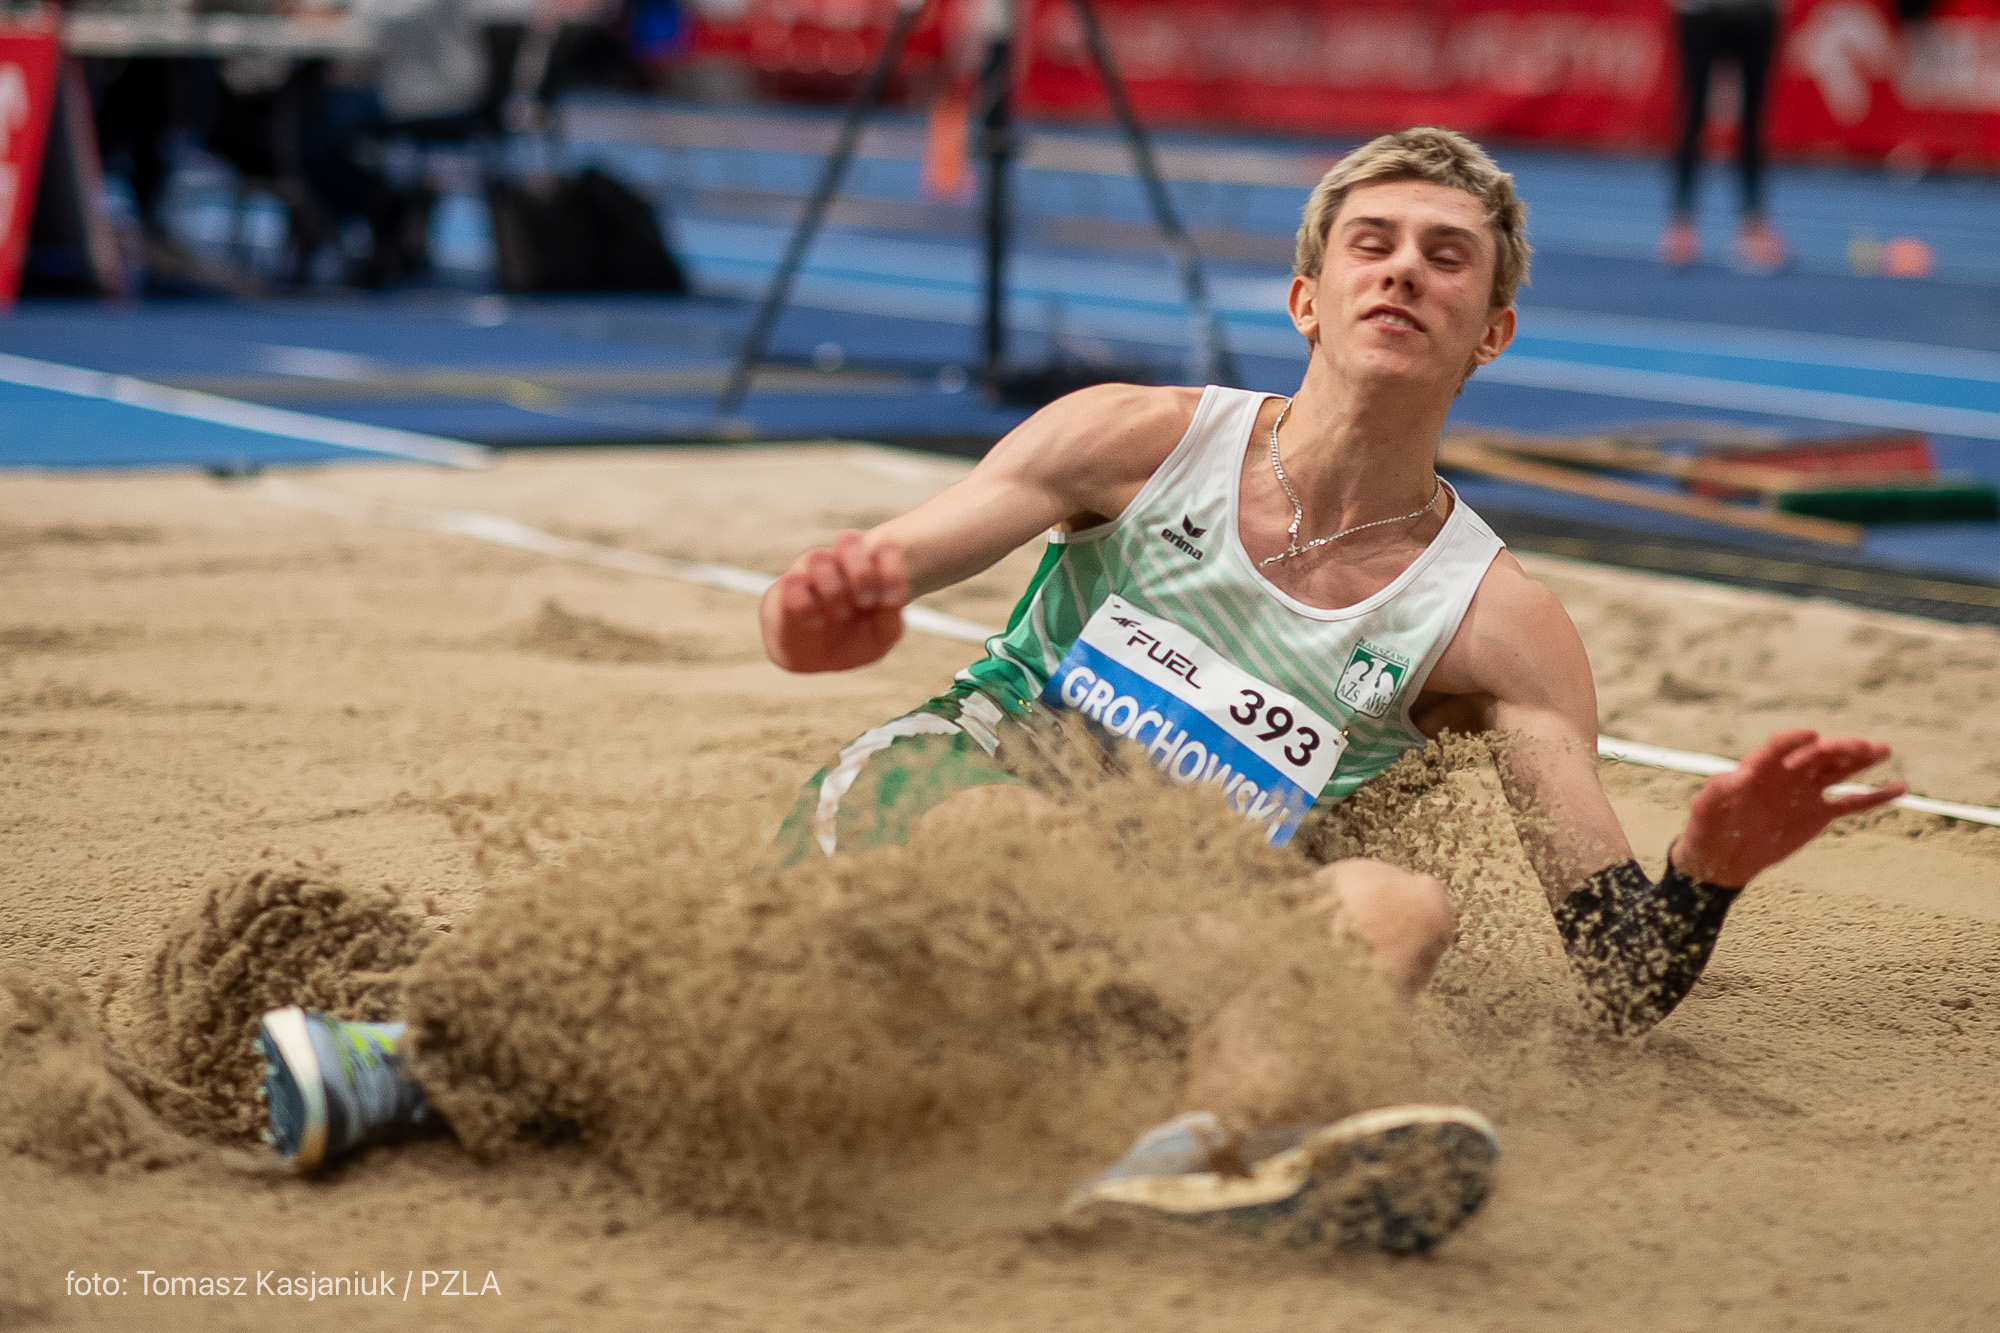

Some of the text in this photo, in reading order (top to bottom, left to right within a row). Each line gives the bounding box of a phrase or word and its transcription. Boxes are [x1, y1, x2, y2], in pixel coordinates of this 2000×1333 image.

[1161, 528, 1204, 561] erima
[1127, 629, 1202, 689] FUEL
[1339, 681, 1360, 703] AZS
[1230, 689, 1321, 767] 393
